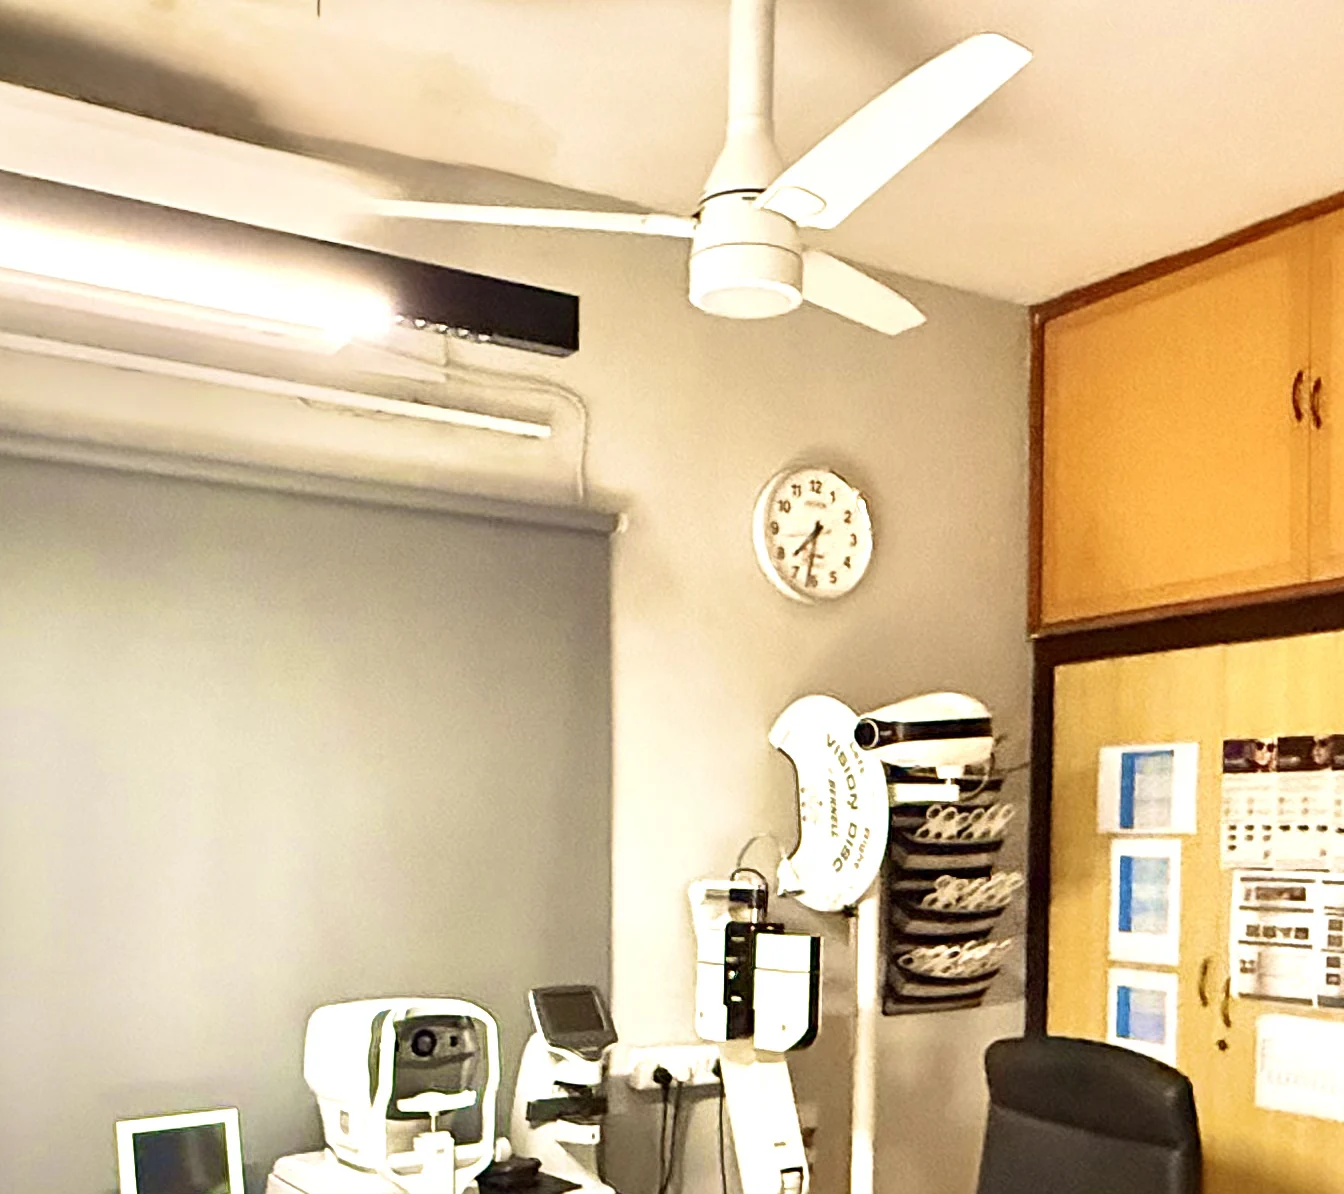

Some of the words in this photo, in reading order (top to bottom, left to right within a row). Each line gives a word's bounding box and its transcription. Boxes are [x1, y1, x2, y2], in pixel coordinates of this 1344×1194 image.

[791, 484, 801, 497] 11
[809, 480, 822, 494] 12
[830, 490, 836, 503] 1
[778, 500, 791, 513] 10
[844, 510, 852, 524] 2
[770, 521, 779, 535] 9
[850, 533, 857, 547] 3
[843, 556, 851, 568] 4
[792, 566, 800, 578] 7
[829, 571, 837, 584] 5
[826, 733, 859, 810] VISION
[831, 821, 858, 873] DISC
